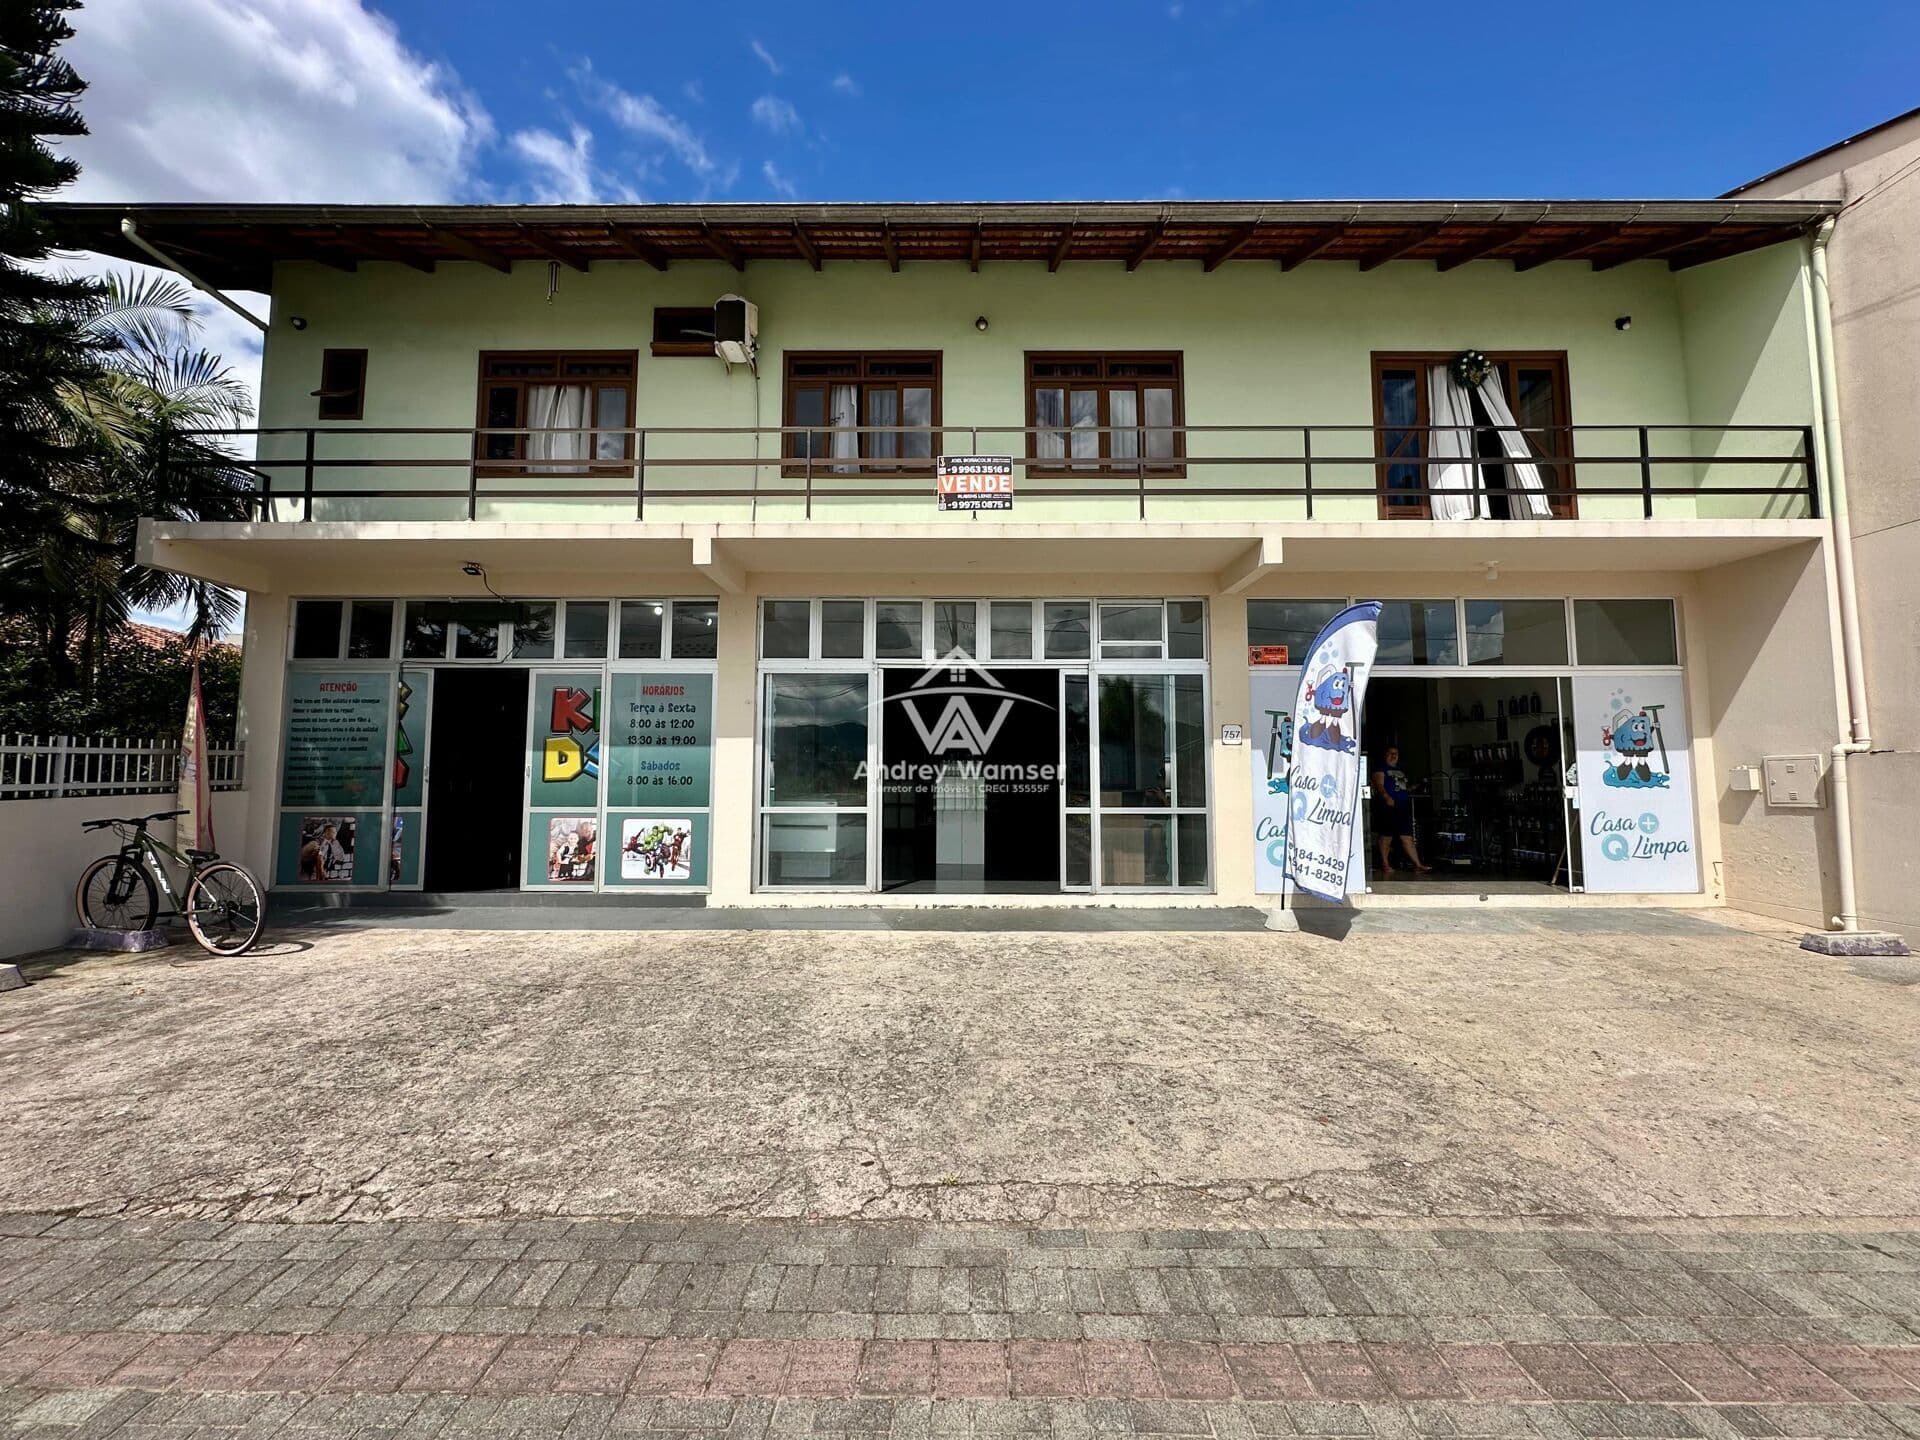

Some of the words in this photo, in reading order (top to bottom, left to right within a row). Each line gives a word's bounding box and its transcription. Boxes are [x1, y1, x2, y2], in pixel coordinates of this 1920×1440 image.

[959, 466, 980, 474] 9963
[982, 466, 1002, 474] 3516
[940, 475, 1010, 493] VENDE
[959, 501, 980, 509] 9975
[982, 501, 1003, 509] 0875
[320, 681, 357, 693] ATENÇÃO
[642, 684, 685, 696] HORÁRIOS
[630, 702, 655, 714] Terça
[668, 703, 696, 713] Sexta
[630, 719, 651, 729] 8:00
[670, 719, 695, 729] 12:00
[1224, 730, 1240, 739] 757
[628, 736, 652, 745] 13:30
[672, 736, 696, 745] 19:00
[640, 760, 680, 771] Sábados
[627, 776, 648, 786] 8:00
[668, 776, 693, 786] 16:00
[1306, 798, 1351, 830] Limpa
[1590, 810, 1637, 836] Casa
[1601, 833, 1630, 861] Q
[1632, 834, 1690, 861] Limpa
